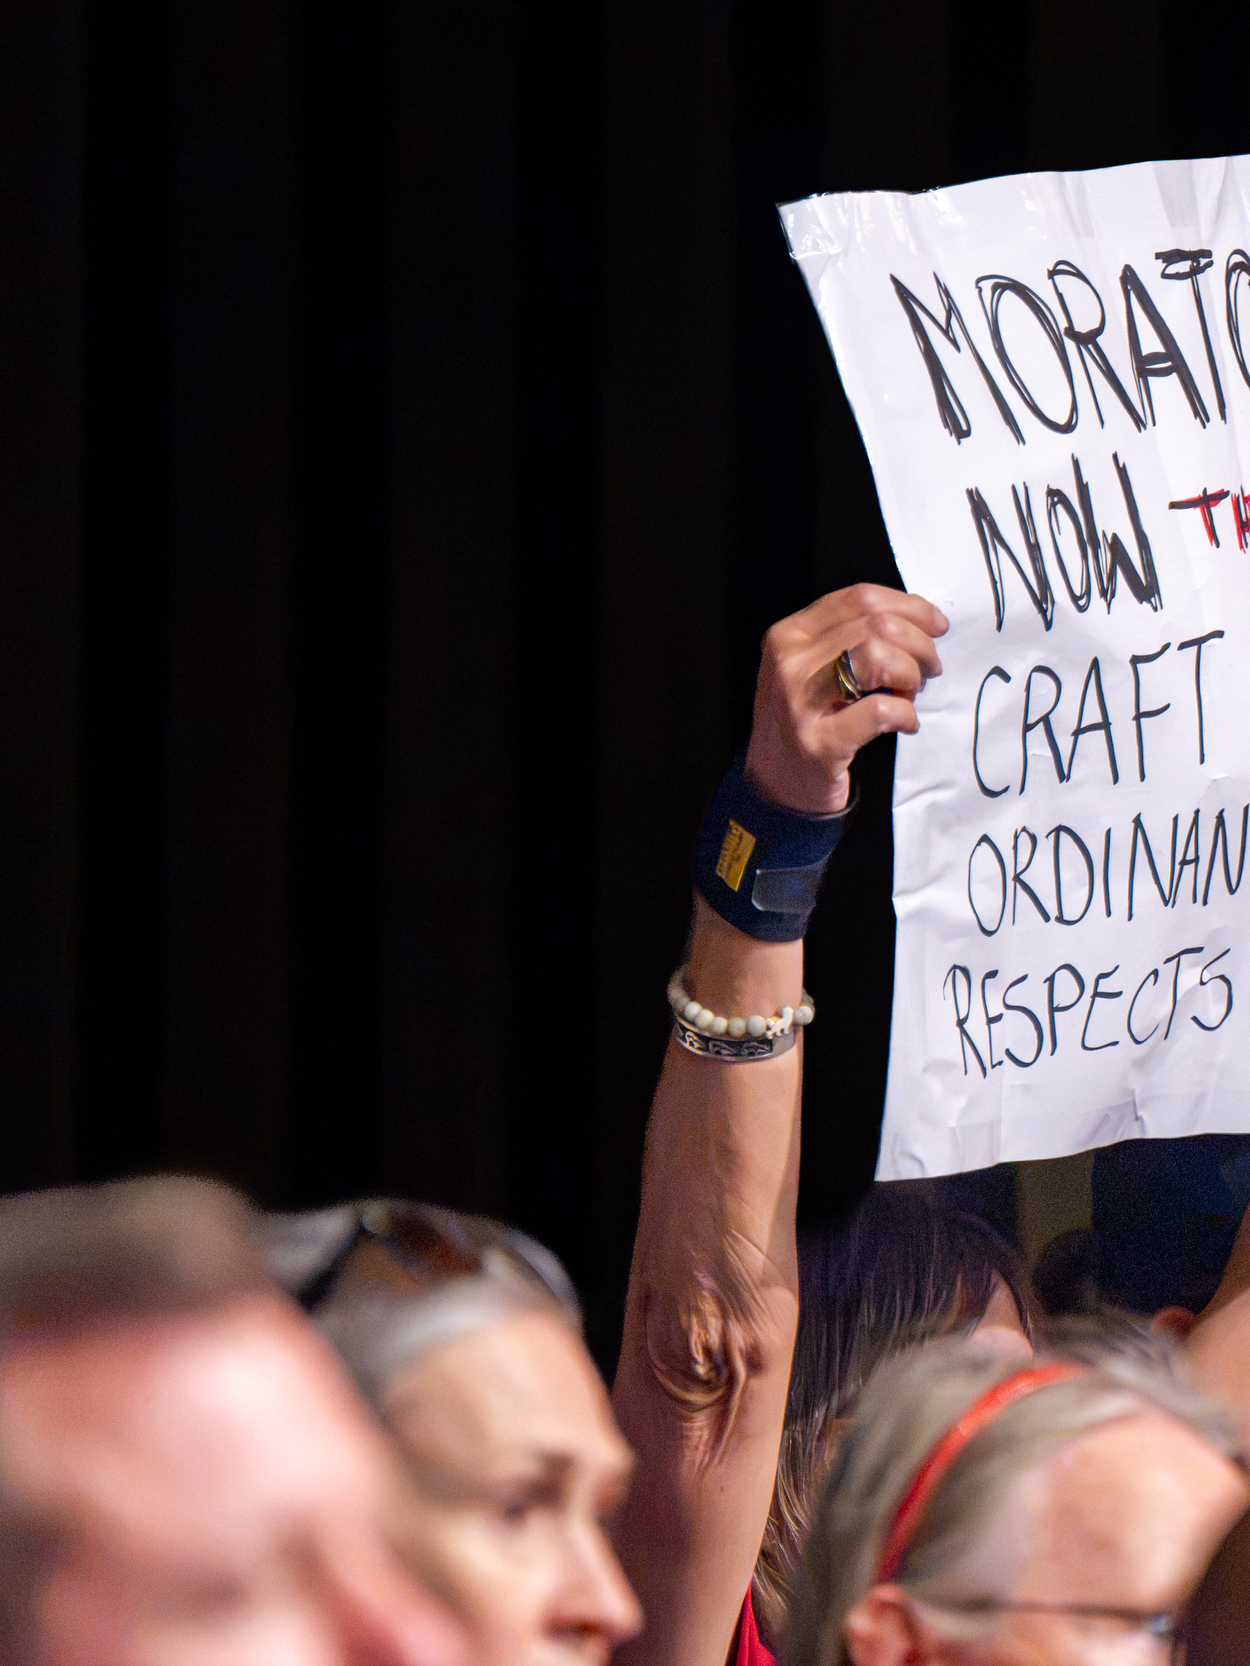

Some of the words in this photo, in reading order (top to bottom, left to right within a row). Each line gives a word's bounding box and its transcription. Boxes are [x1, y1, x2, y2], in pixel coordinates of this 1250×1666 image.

[965, 452, 1163, 633] NOW
[972, 630, 1225, 799] CRAFT
[943, 946, 1234, 1079] RESPECTS
